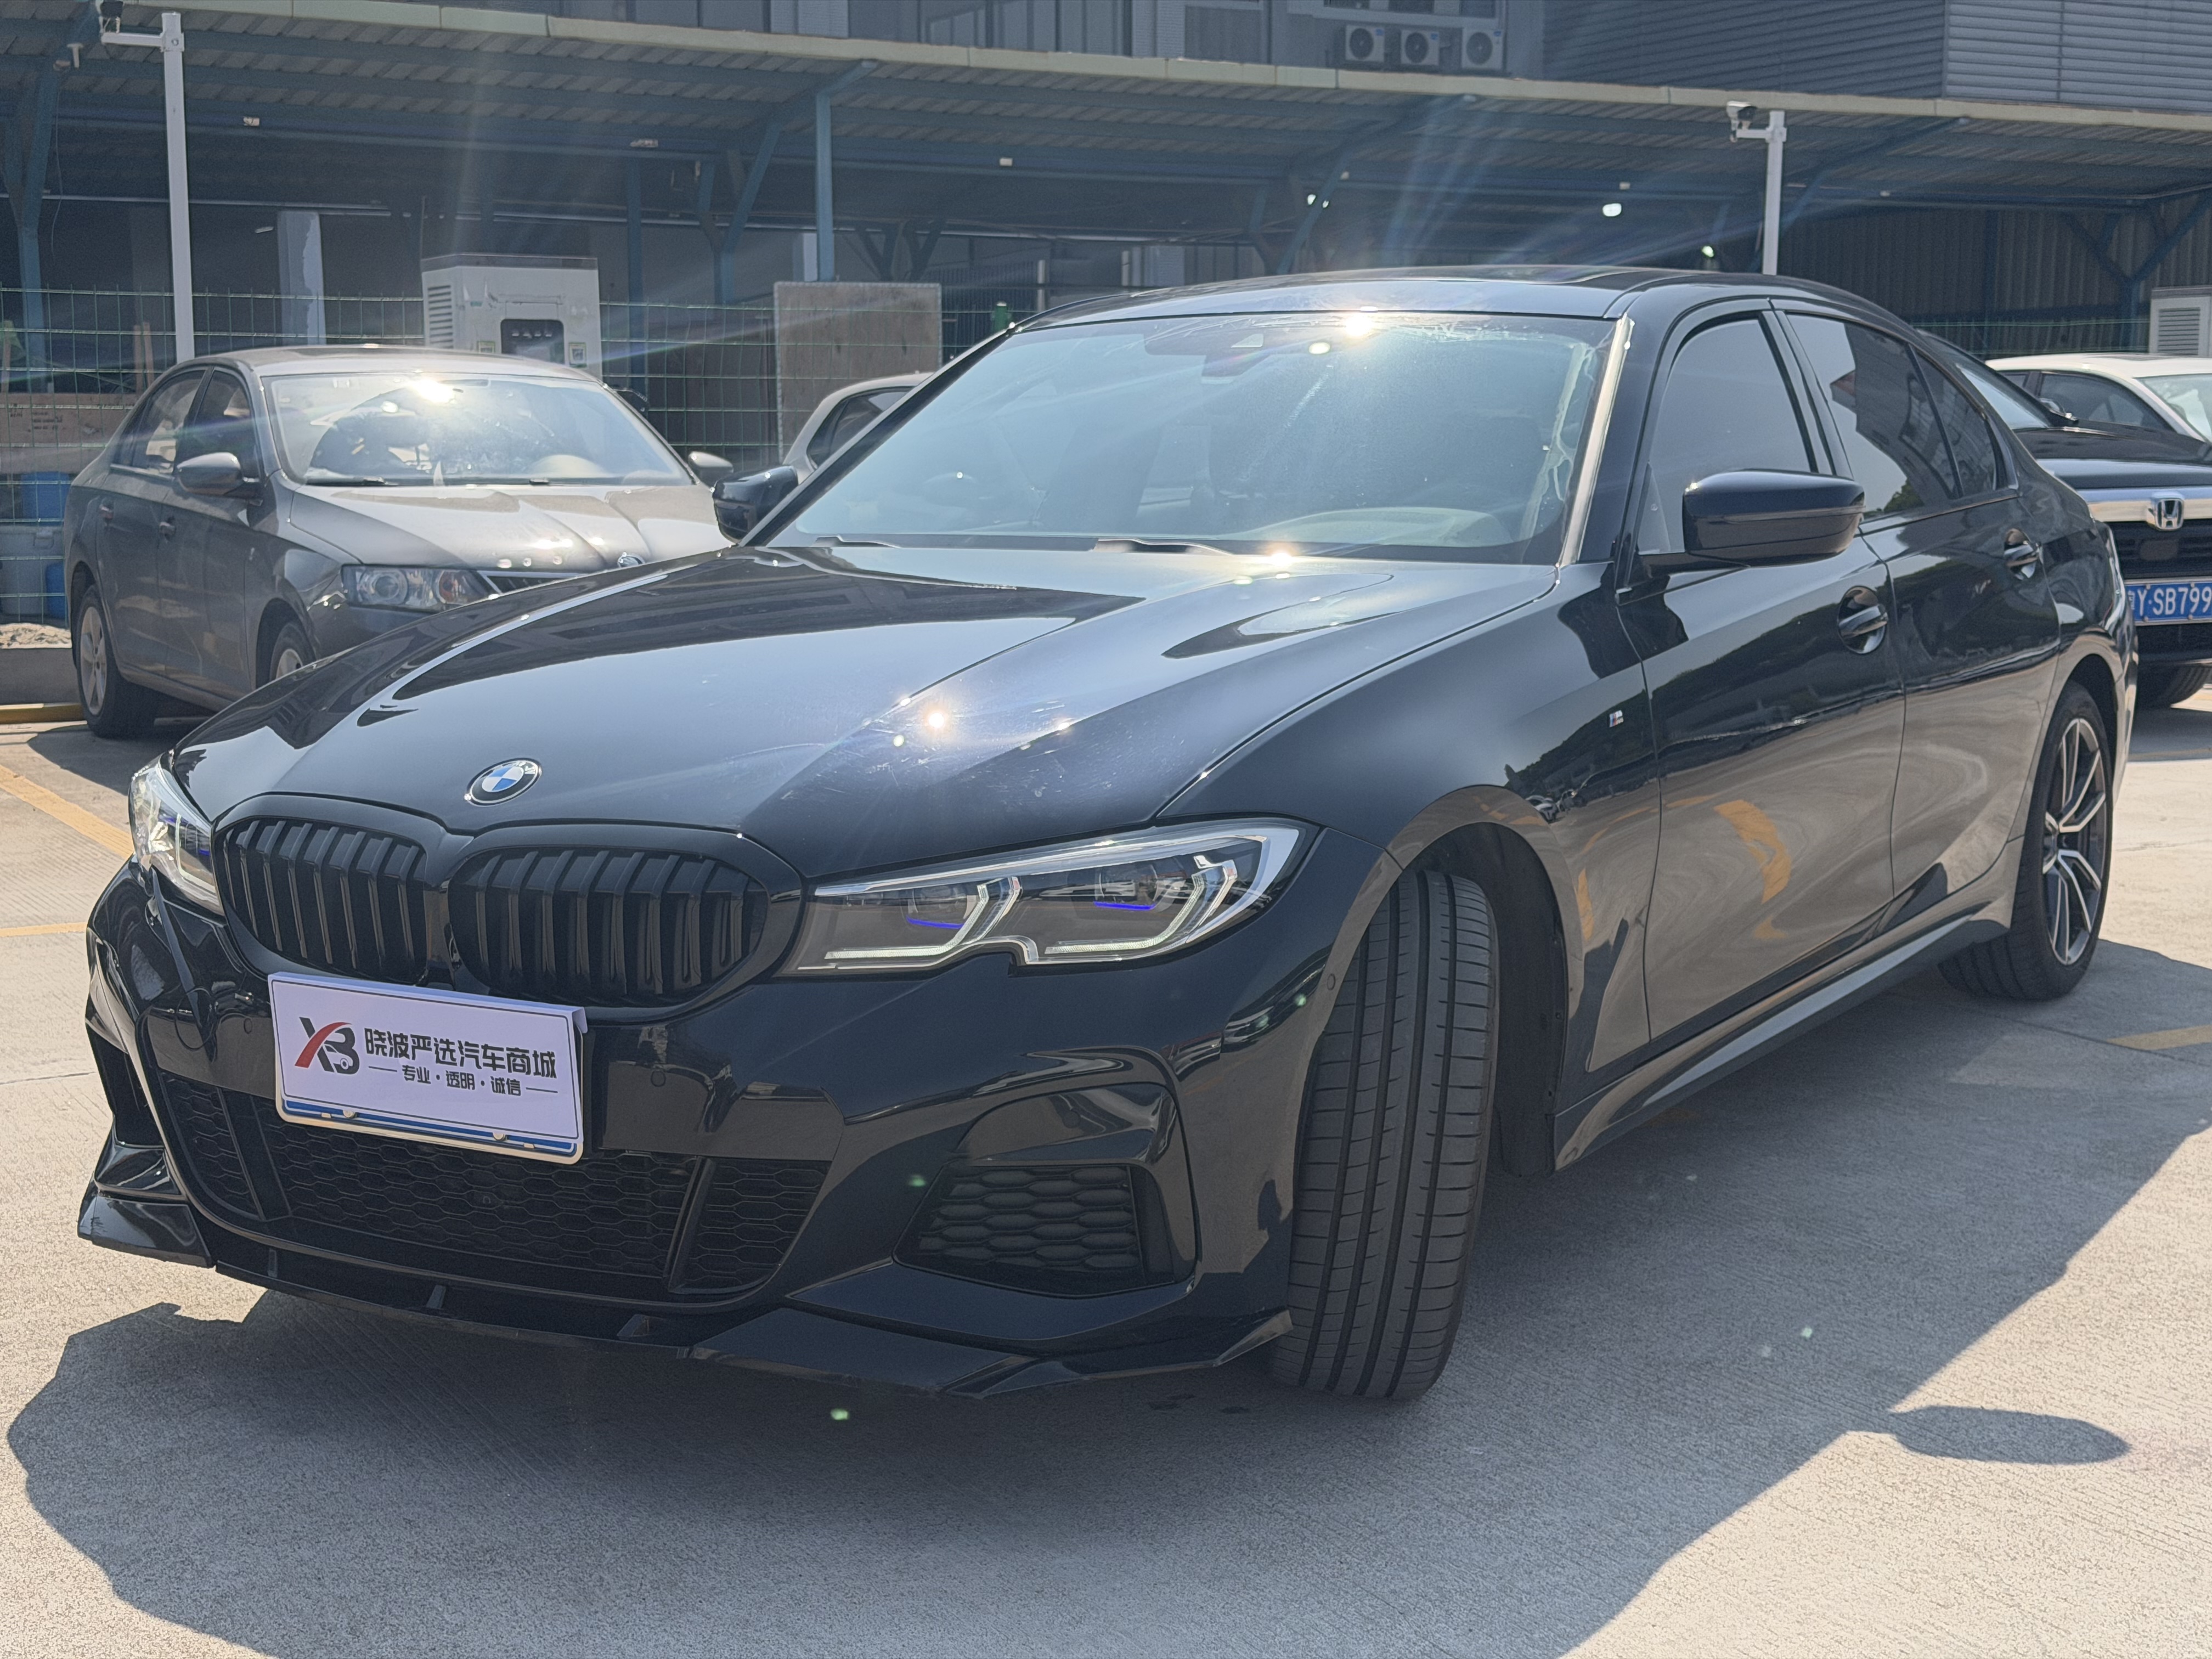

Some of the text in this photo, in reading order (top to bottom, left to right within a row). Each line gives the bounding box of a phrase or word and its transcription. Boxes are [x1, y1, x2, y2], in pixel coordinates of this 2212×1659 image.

[364, 1028, 557, 1078] 晓波严选汽车商城
